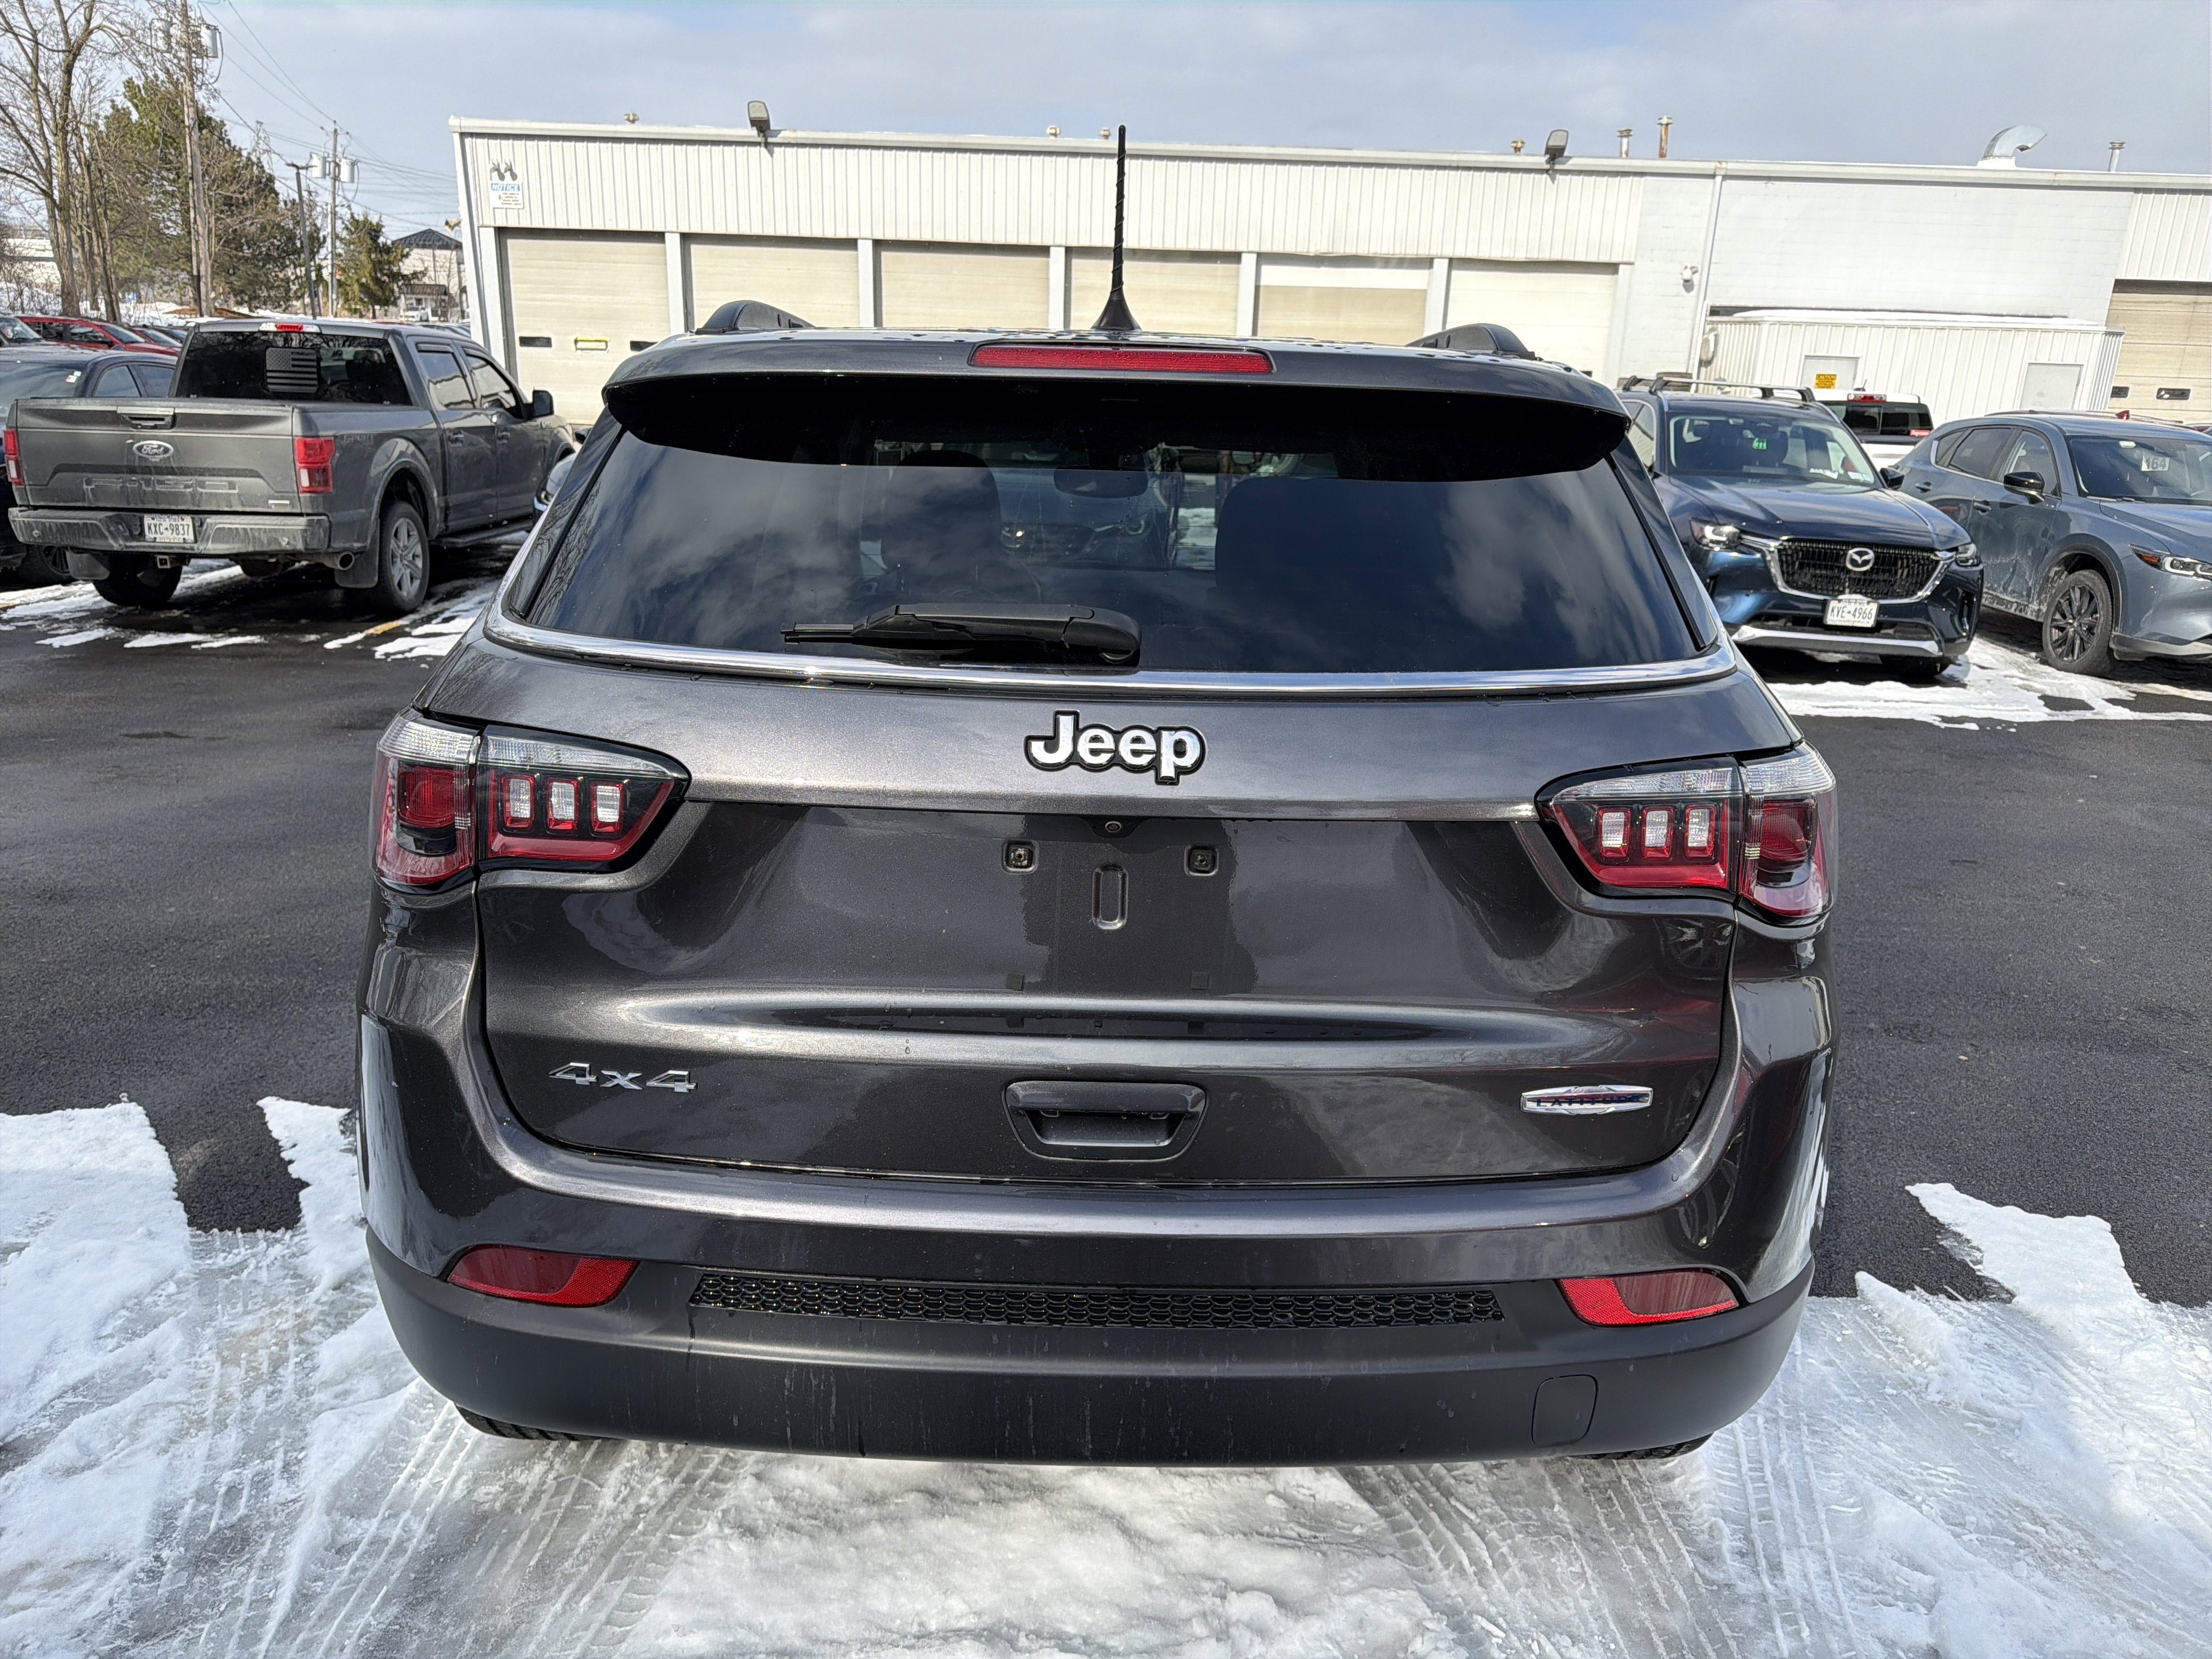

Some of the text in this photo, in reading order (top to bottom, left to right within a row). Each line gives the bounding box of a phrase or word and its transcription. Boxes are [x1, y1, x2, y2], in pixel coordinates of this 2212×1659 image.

[142, 444, 164, 454] Ford
[2145, 456, 2166, 470] 164
[1029, 713, 1203, 780] Jeep
[1537, 1094, 1641, 1107] LATITUDE
